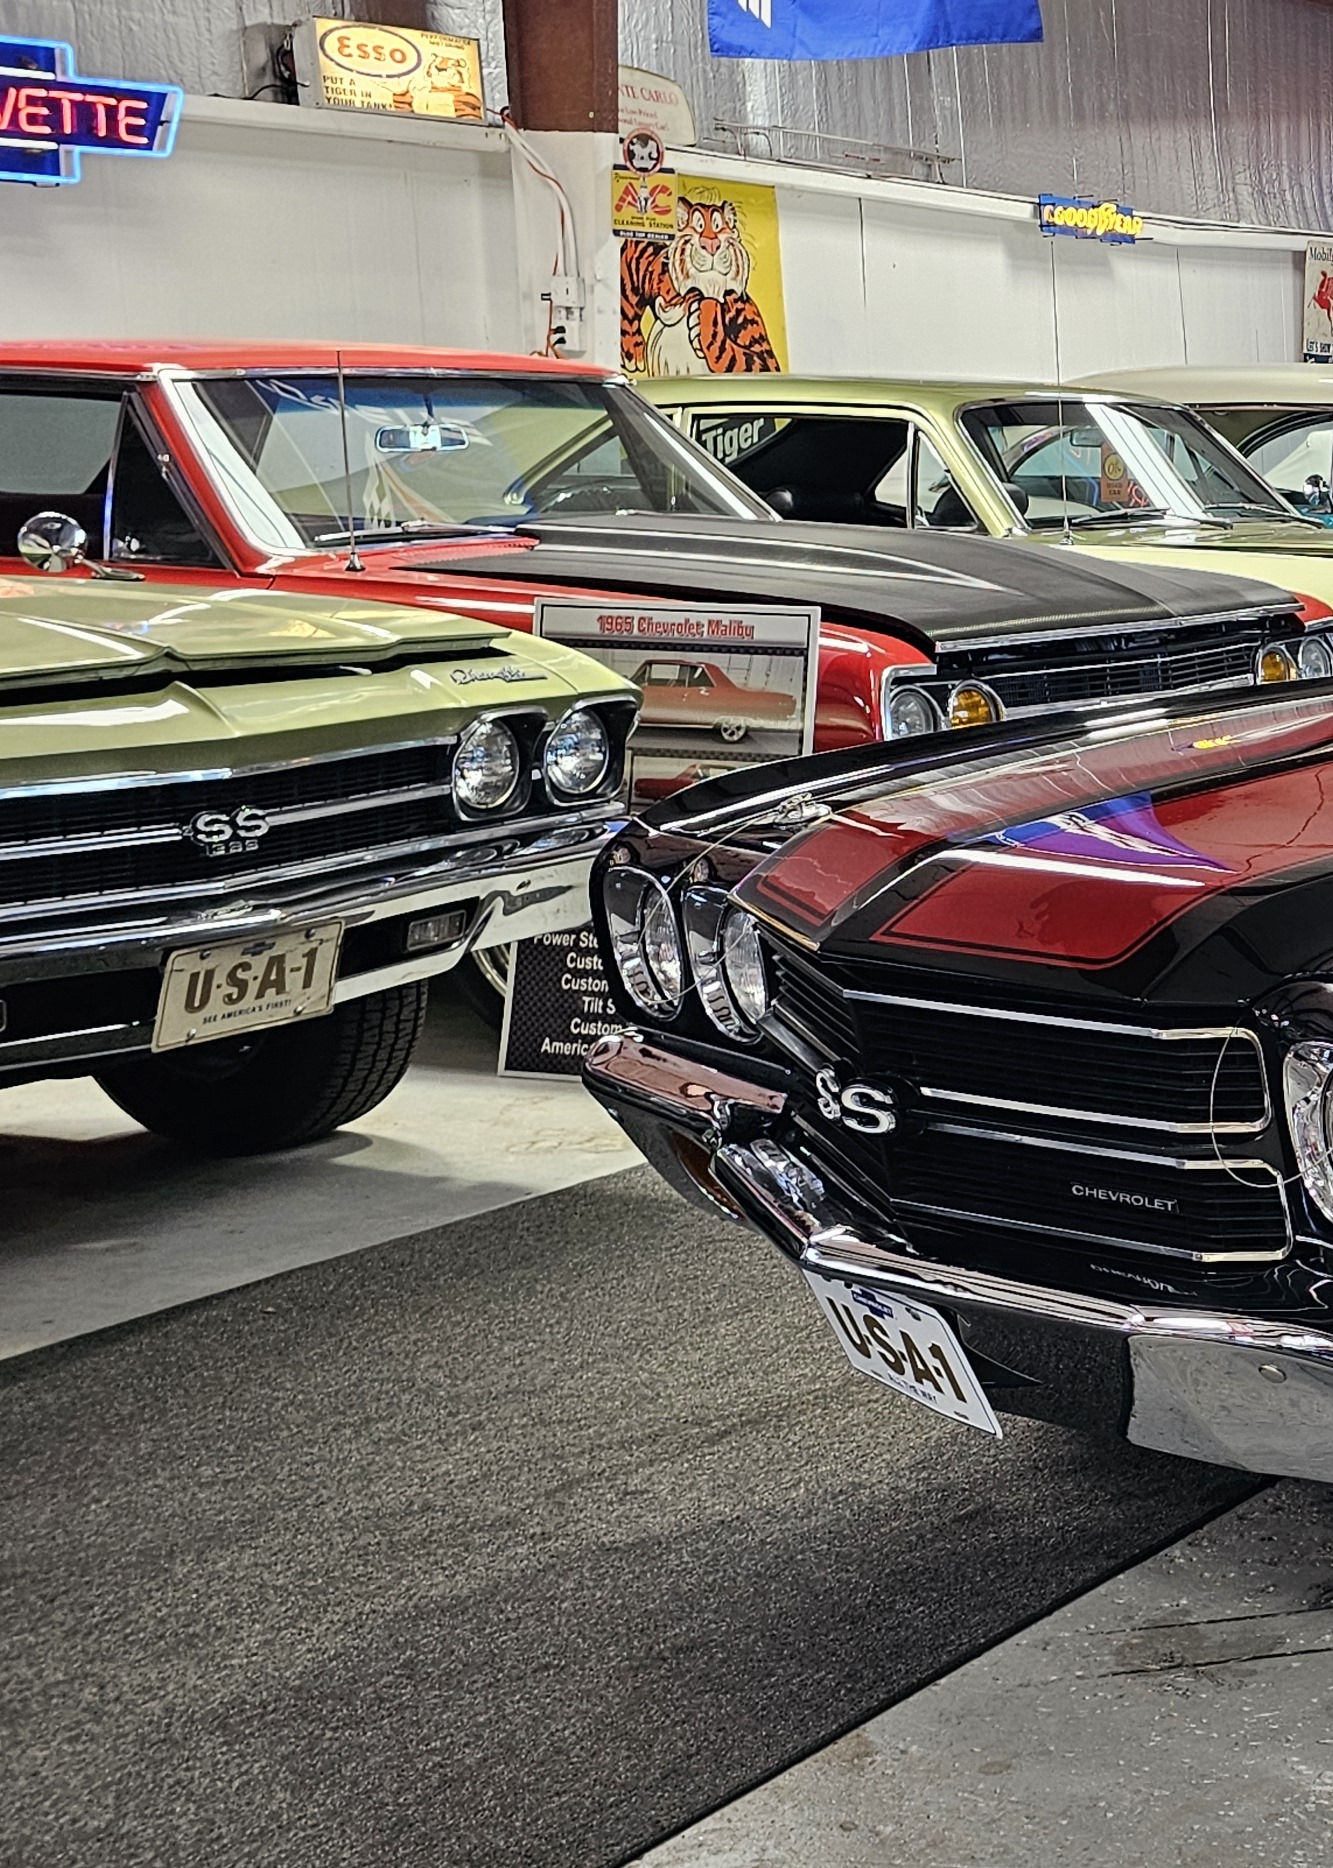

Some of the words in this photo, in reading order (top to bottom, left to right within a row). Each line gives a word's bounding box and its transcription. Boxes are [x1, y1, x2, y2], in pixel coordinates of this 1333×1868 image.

[322, 75, 344, 86] PUT
[325, 86, 357, 97] TIGER
[640, 87, 679, 106] CARLO
[614, 182, 673, 216] AC
[701, 418, 765, 465] Tiger
[637, 616, 704, 637] Chevrolet
[707, 619, 755, 640] Malibu
[196, 808, 270, 843] SS
[202, 1015, 218, 1025] SEE
[220, 1004, 263, 1021] AMERICA'S
[582, 996, 604, 1014] Tilt
[541, 1037, 591, 1056] Americ
[1071, 1184, 1176, 1212] CHEVROLET
